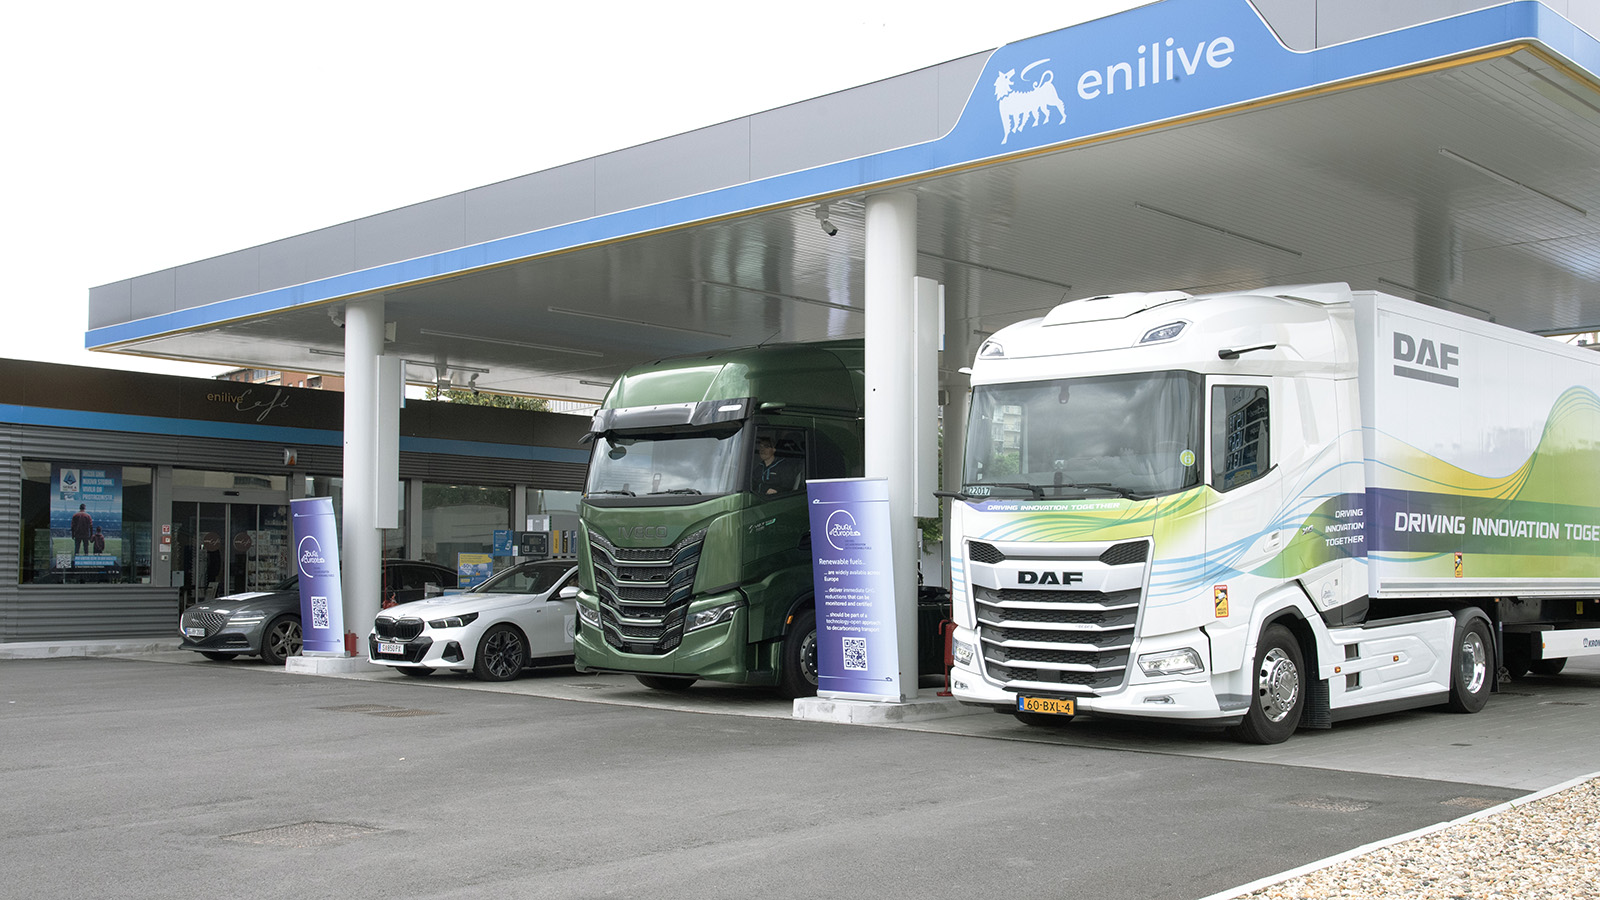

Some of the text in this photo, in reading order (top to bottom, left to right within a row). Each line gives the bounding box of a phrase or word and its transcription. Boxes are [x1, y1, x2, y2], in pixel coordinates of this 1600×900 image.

[1077, 36, 1235, 100] enilive
[1393, 331, 1459, 370] DAF
[207, 388, 290, 422] enilive Café
[1184, 455, 1192, 464] 6
[1335, 508, 1364, 518] DRIVING
[618, 526, 668, 540] IVECO
[1325, 522, 1364, 533] INNOVATION
[1394, 512, 1466, 535] DRIVING
[1472, 517, 1560, 540] INNOVATION
[1326, 535, 1364, 546] TOGETHER
[1018, 571, 1083, 586] DAF
[1027, 700, 1071, 712] 60-BXL-4
